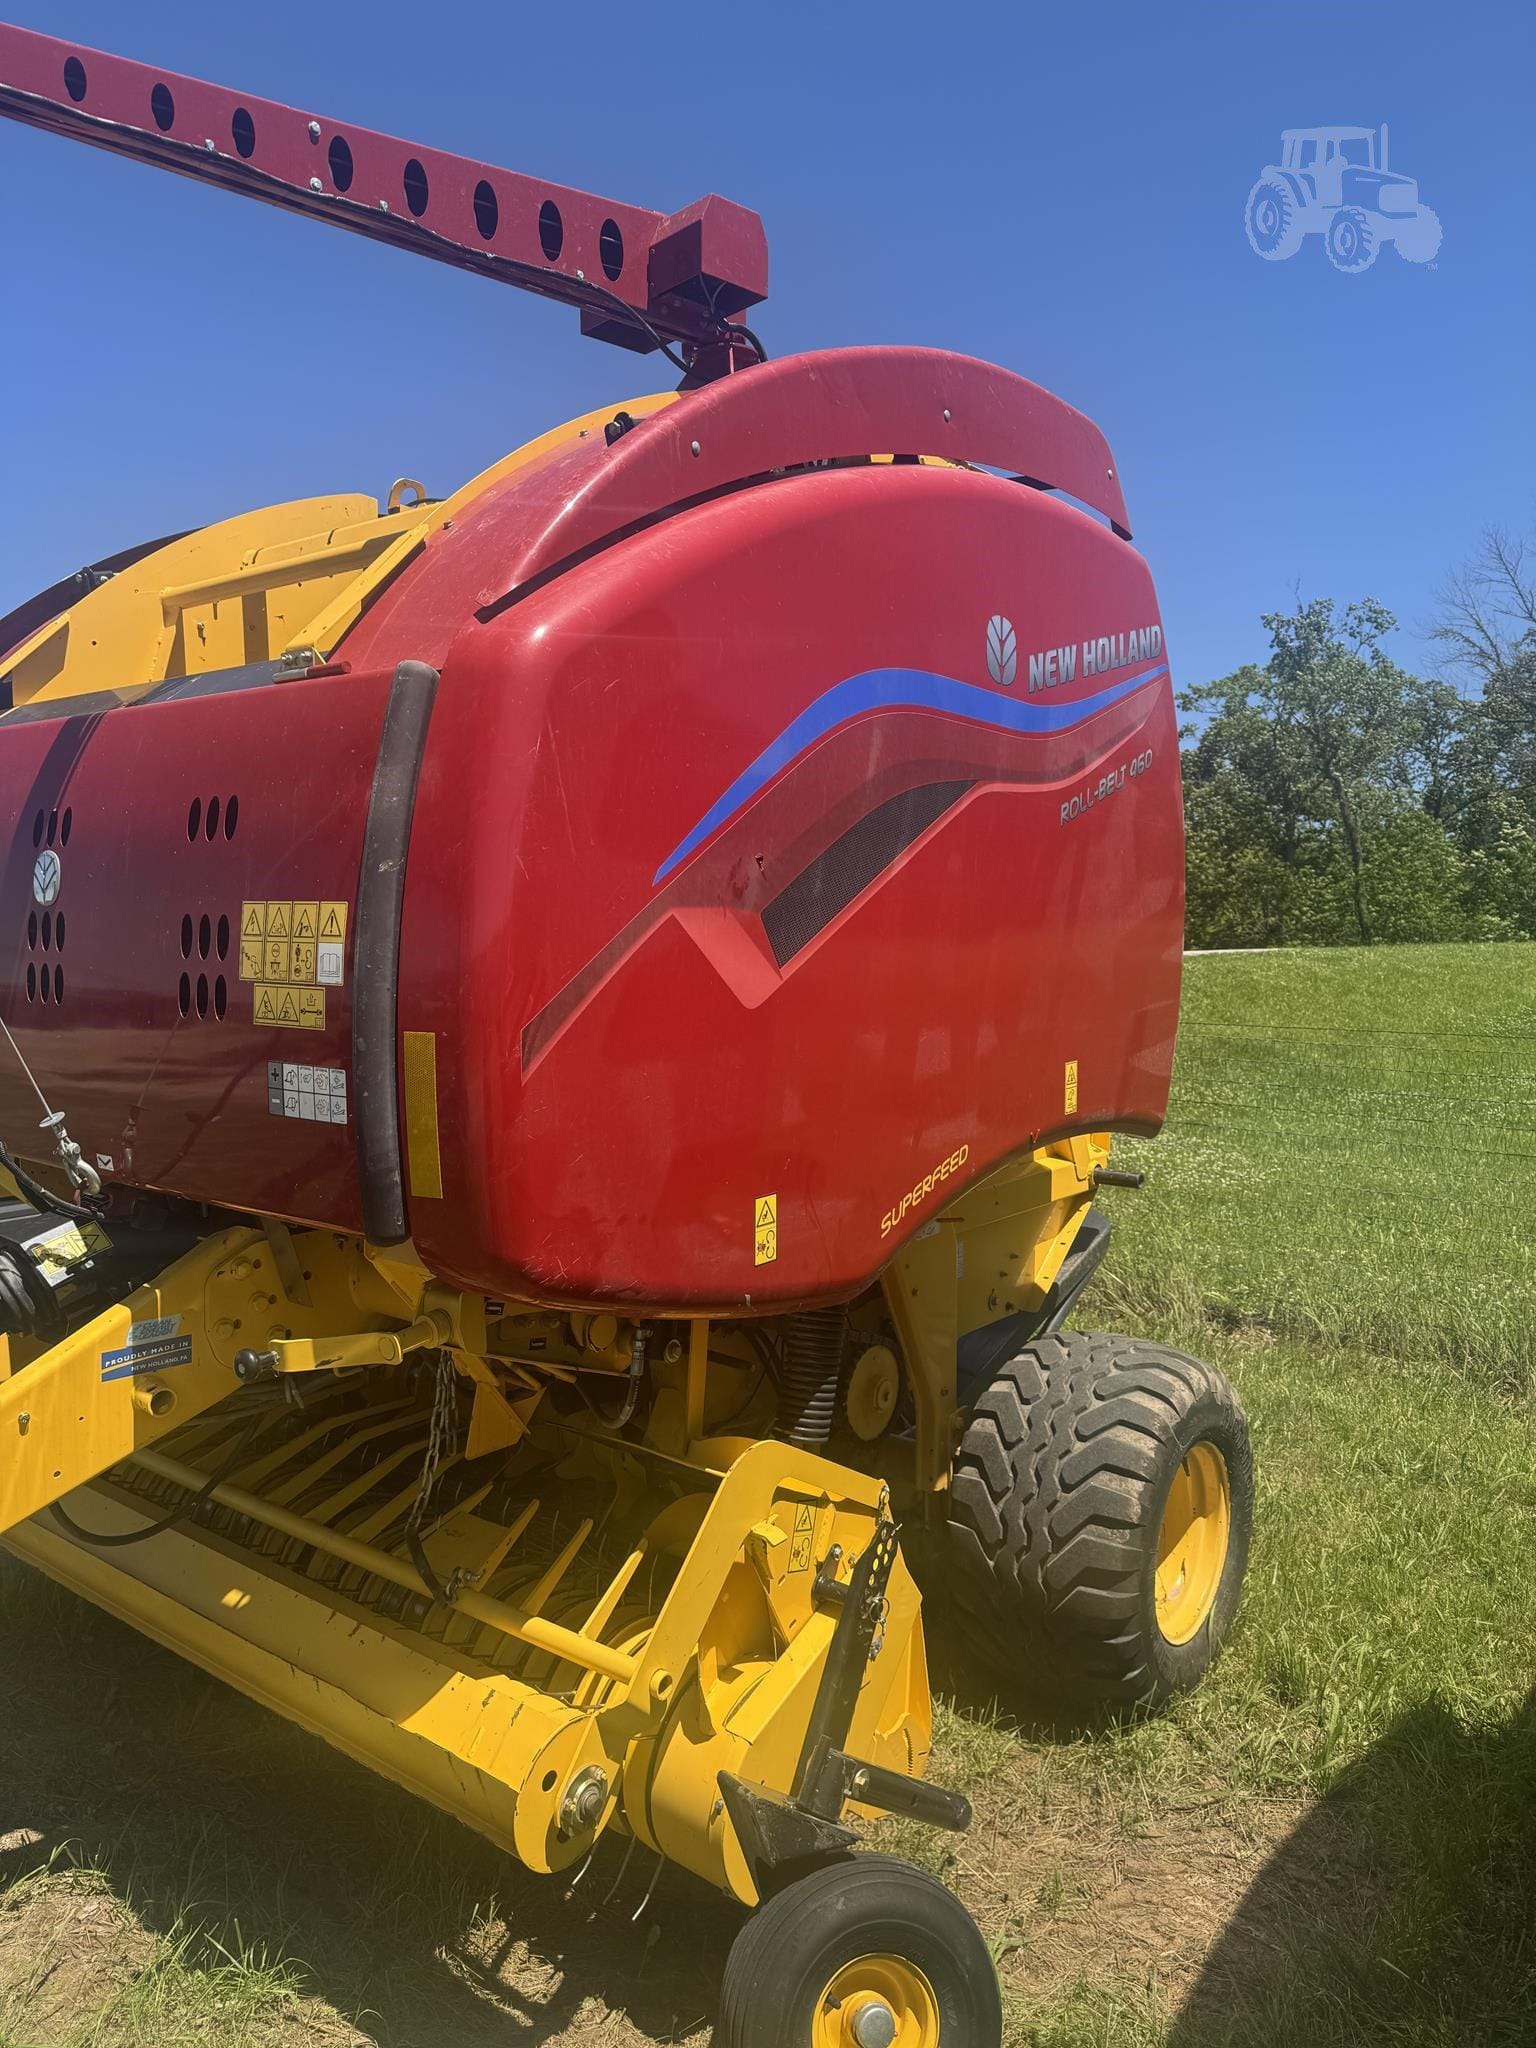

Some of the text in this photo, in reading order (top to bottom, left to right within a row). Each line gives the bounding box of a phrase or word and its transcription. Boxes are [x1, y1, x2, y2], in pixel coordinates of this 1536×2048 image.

[1028, 624, 1162, 694] NEW HOLLAND
[1059, 748, 1153, 827] ROLL-BELT 460
[881, 1144, 969, 1239] SUPERFEED
[105, 1340, 189, 1368] PROUDLY MADE IN
[131, 1362, 147, 1373] NEW
[180, 1354, 188, 1362] PA
